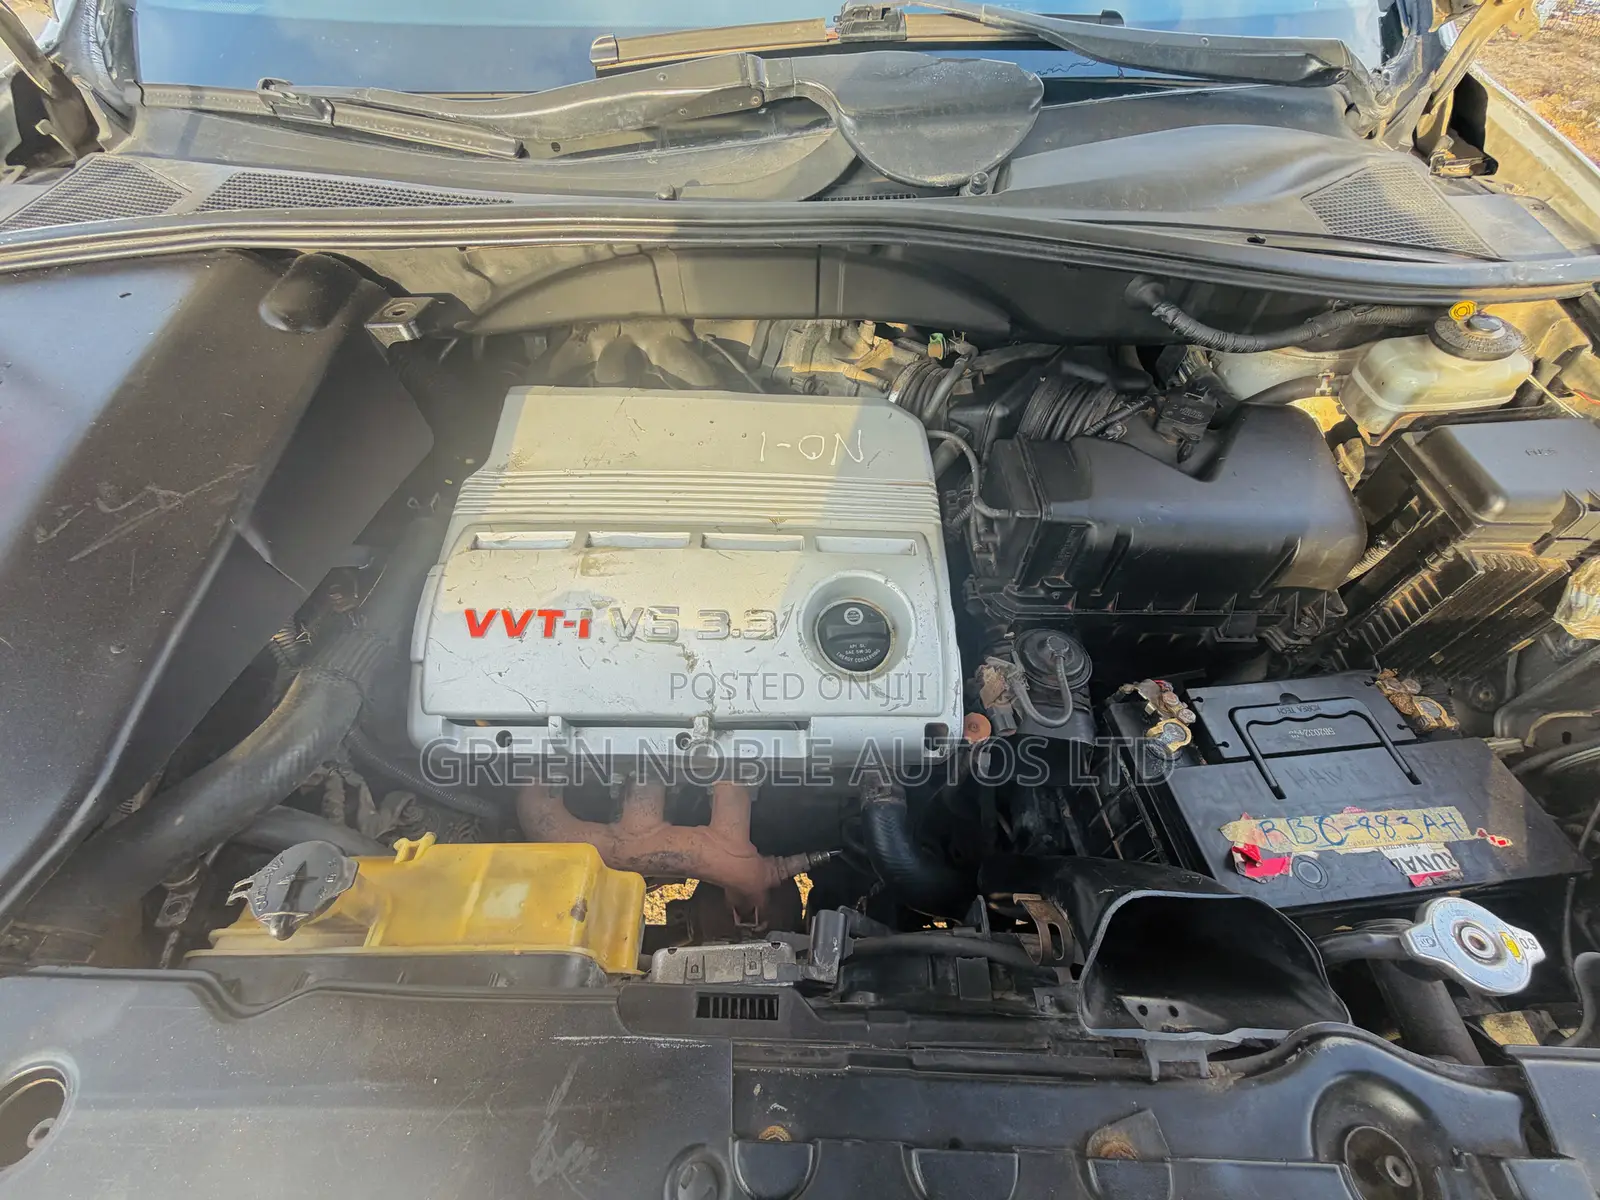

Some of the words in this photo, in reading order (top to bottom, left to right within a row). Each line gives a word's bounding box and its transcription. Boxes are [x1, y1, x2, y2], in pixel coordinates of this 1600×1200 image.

[464, 608, 593, 640] VVT-i
[609, 605, 680, 643] V6
[697, 607, 777, 641] 3.3
